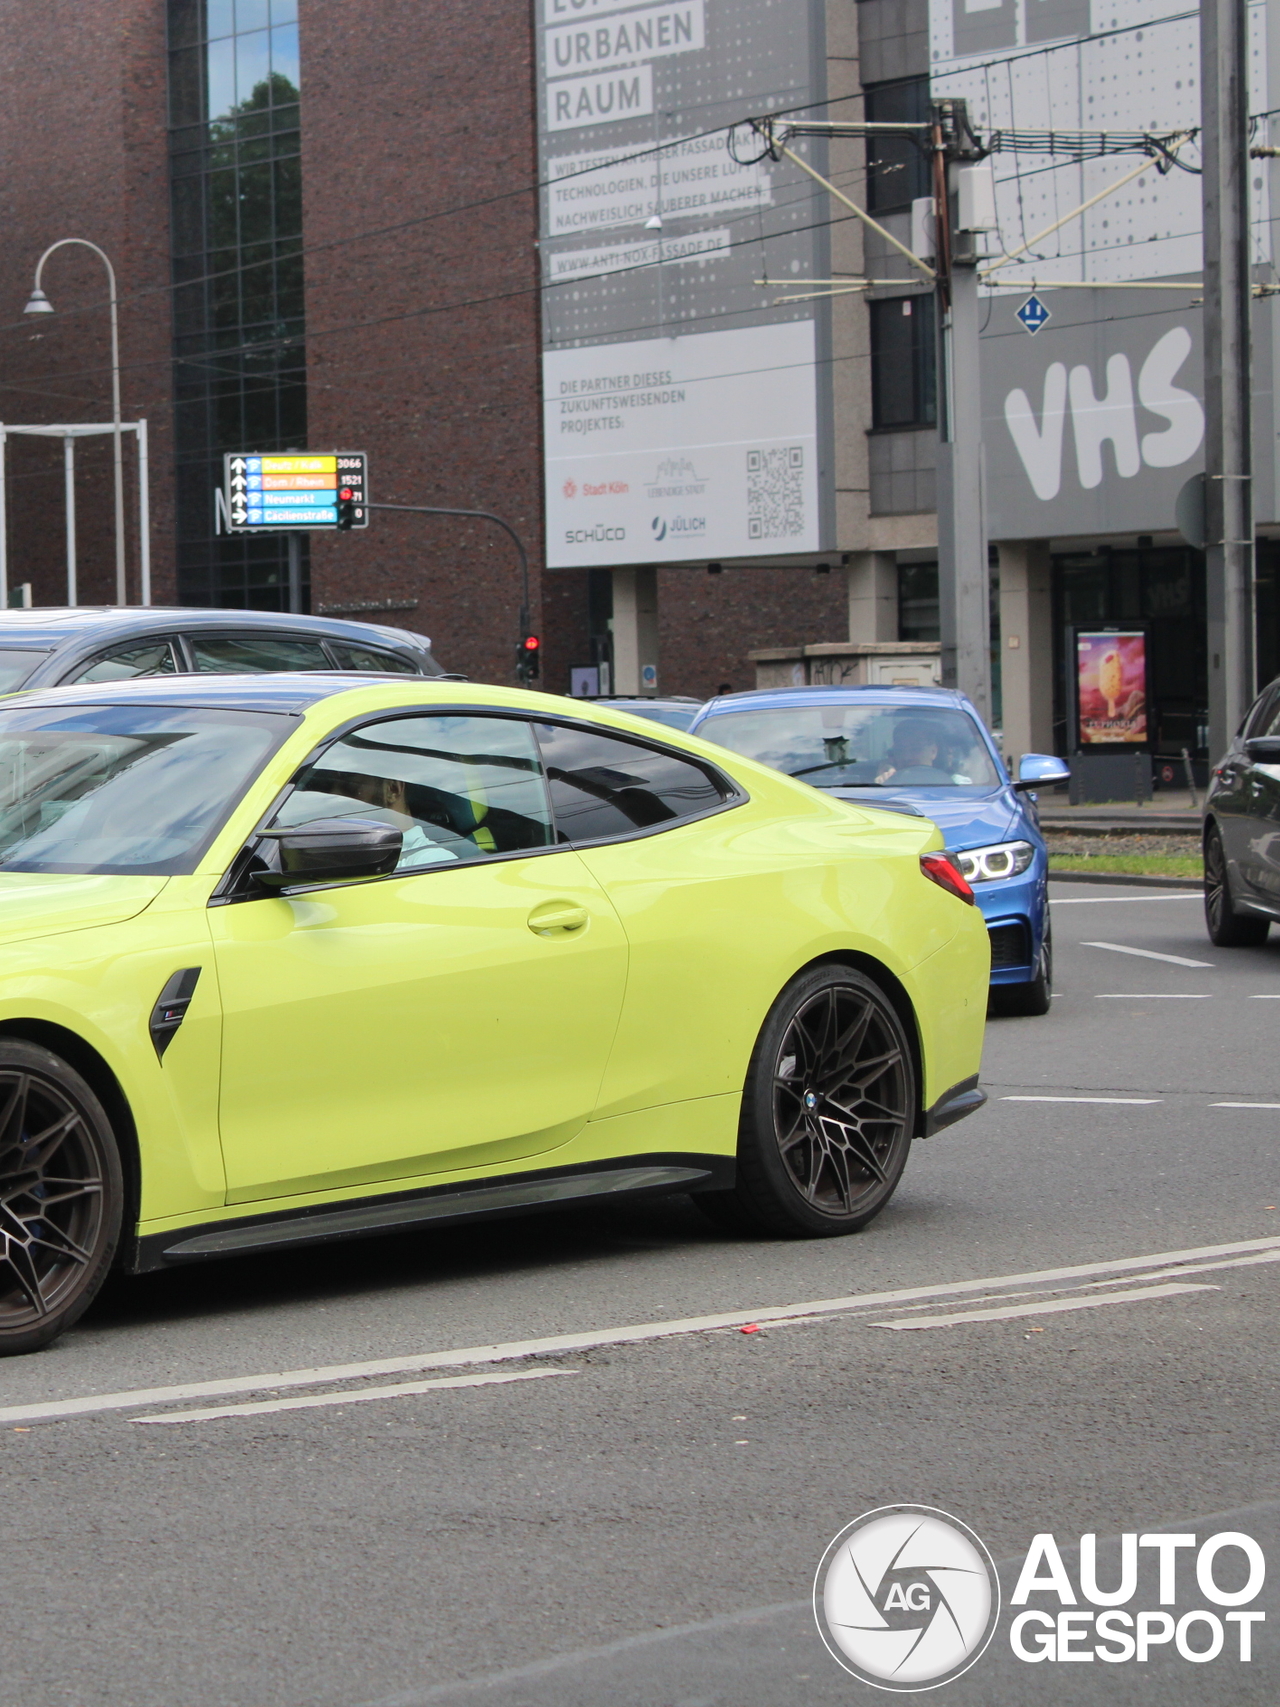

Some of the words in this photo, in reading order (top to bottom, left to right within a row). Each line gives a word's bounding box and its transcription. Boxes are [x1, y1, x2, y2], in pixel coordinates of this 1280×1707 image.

[554, 10, 693, 68] URBANEN
[556, 76, 641, 122] RAUM
[555, 162, 576, 177] WIR
[672, 165, 719, 185] UNSERE
[722, 161, 752, 177] LUFT
[556, 202, 643, 228] NACHWEISLICH
[647, 191, 706, 214] SAUBERER
[560, 380, 578, 394] DIE
[581, 375, 630, 392] PARTNER
[633, 370, 672, 386] DIESES
[560, 389, 686, 414] ZUKUNFTSWEISENDEN
[1004, 326, 1206, 501] VHS
[560, 416, 625, 435] PROJEKTES:
[337, 458, 362, 469] 3066
[265, 477, 288, 488] Dom
[296, 476, 325, 487] Rhein
[341, 475, 362, 485] 1521
[583, 482, 607, 496] Stadt
[609, 480, 629, 494] Köln
[265, 493, 315, 504] Neumarkt
[265, 509, 334, 521] Cäcilienstraße
[670, 515, 706, 532] JÜLICH
[565, 523, 626, 544] SCHÜCO
